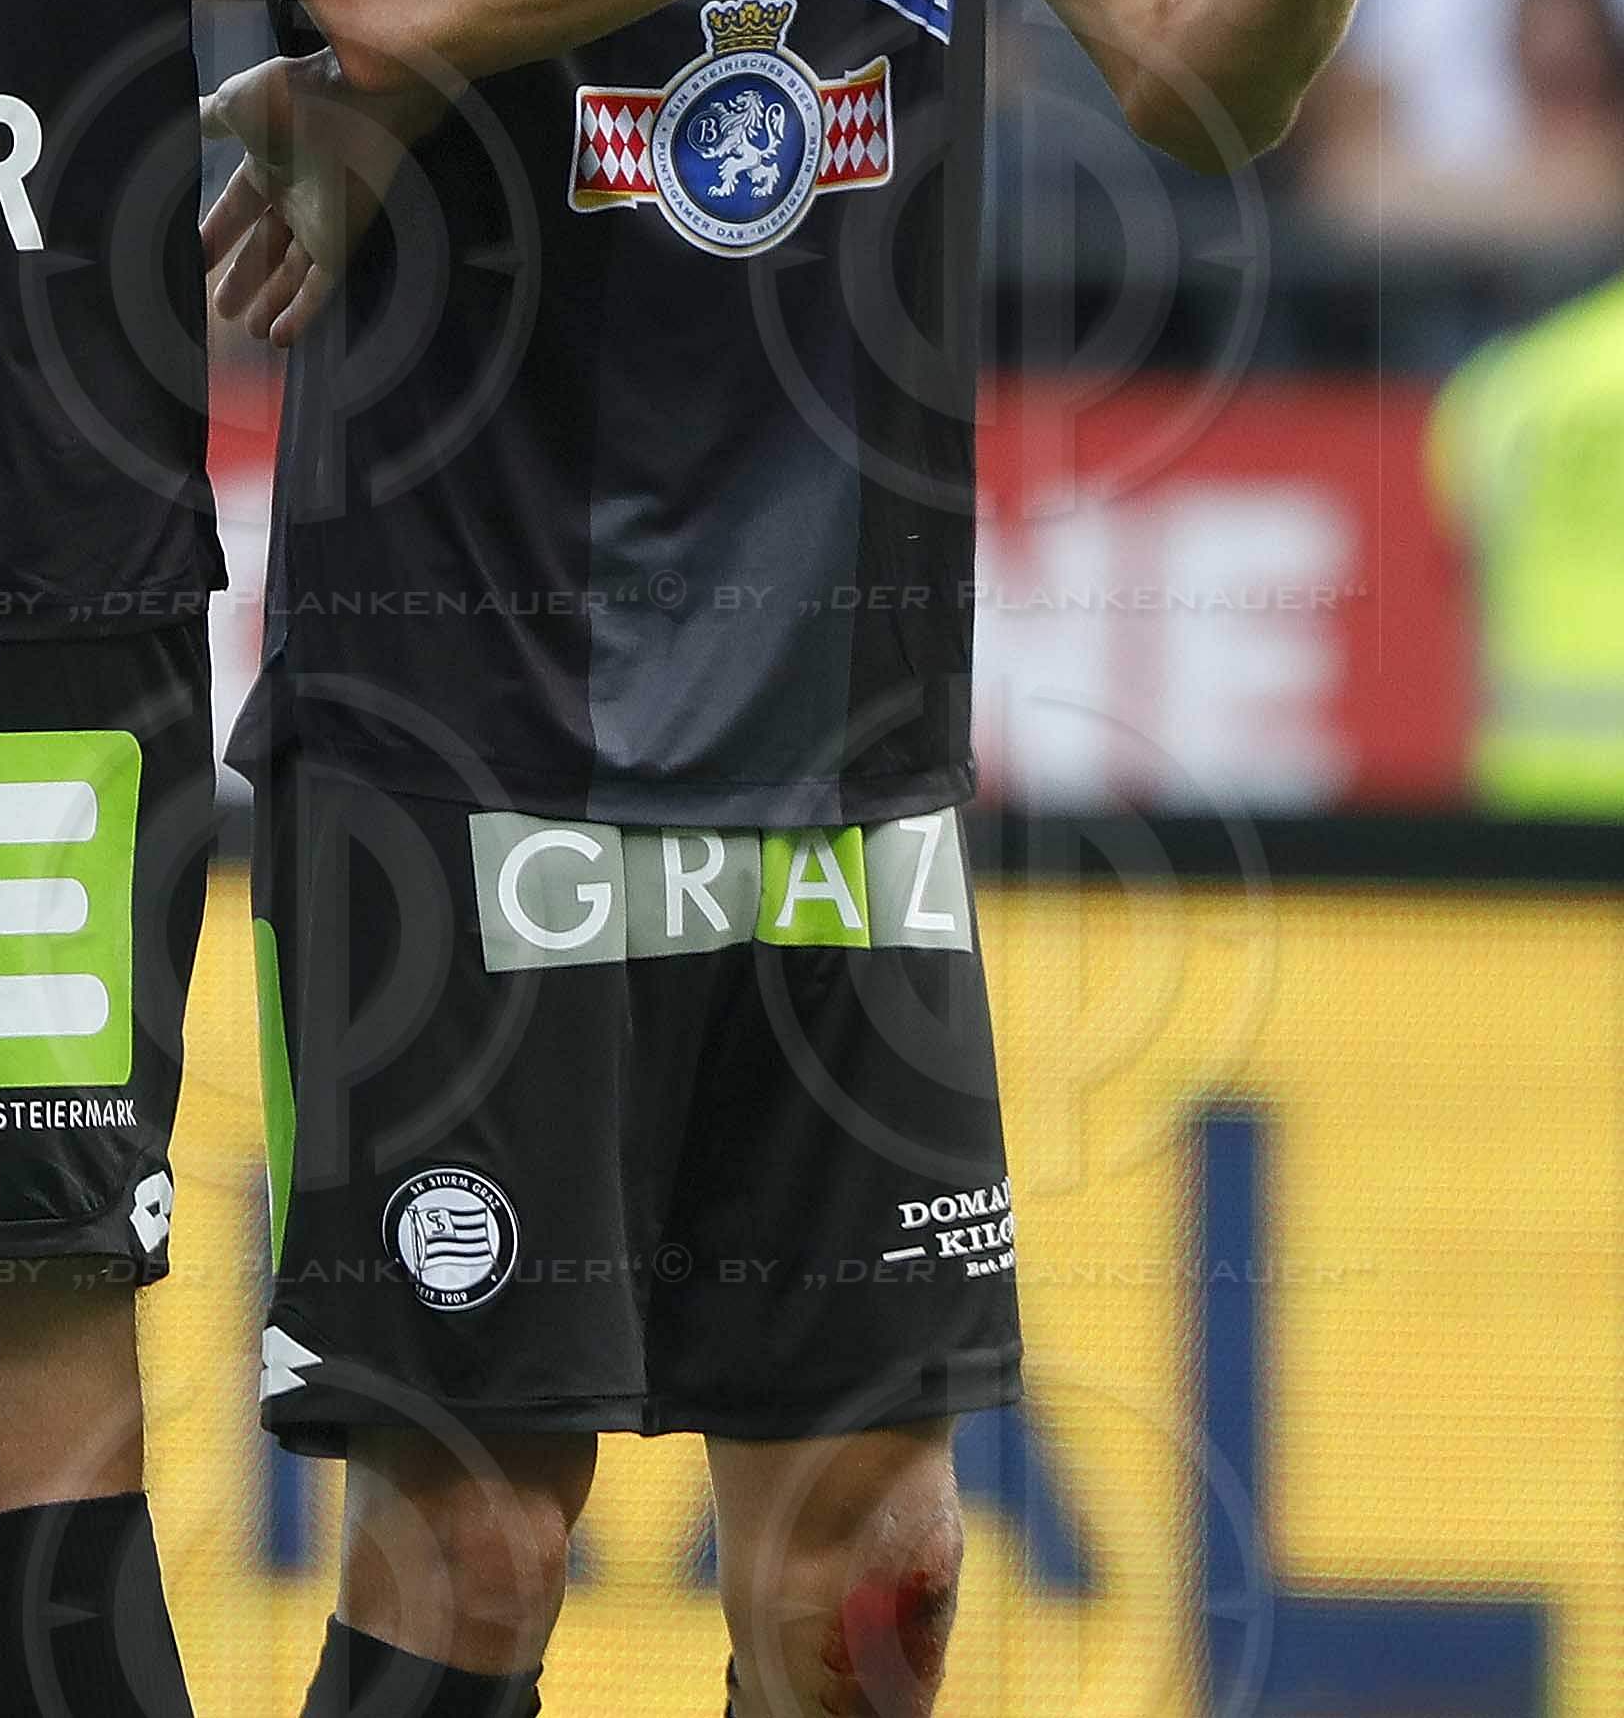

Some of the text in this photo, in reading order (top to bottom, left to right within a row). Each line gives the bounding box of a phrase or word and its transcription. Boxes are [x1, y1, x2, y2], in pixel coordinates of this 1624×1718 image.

[494, 814, 958, 950] GRAZ
[409, 1175, 502, 1211] SK STURM GRAZ
